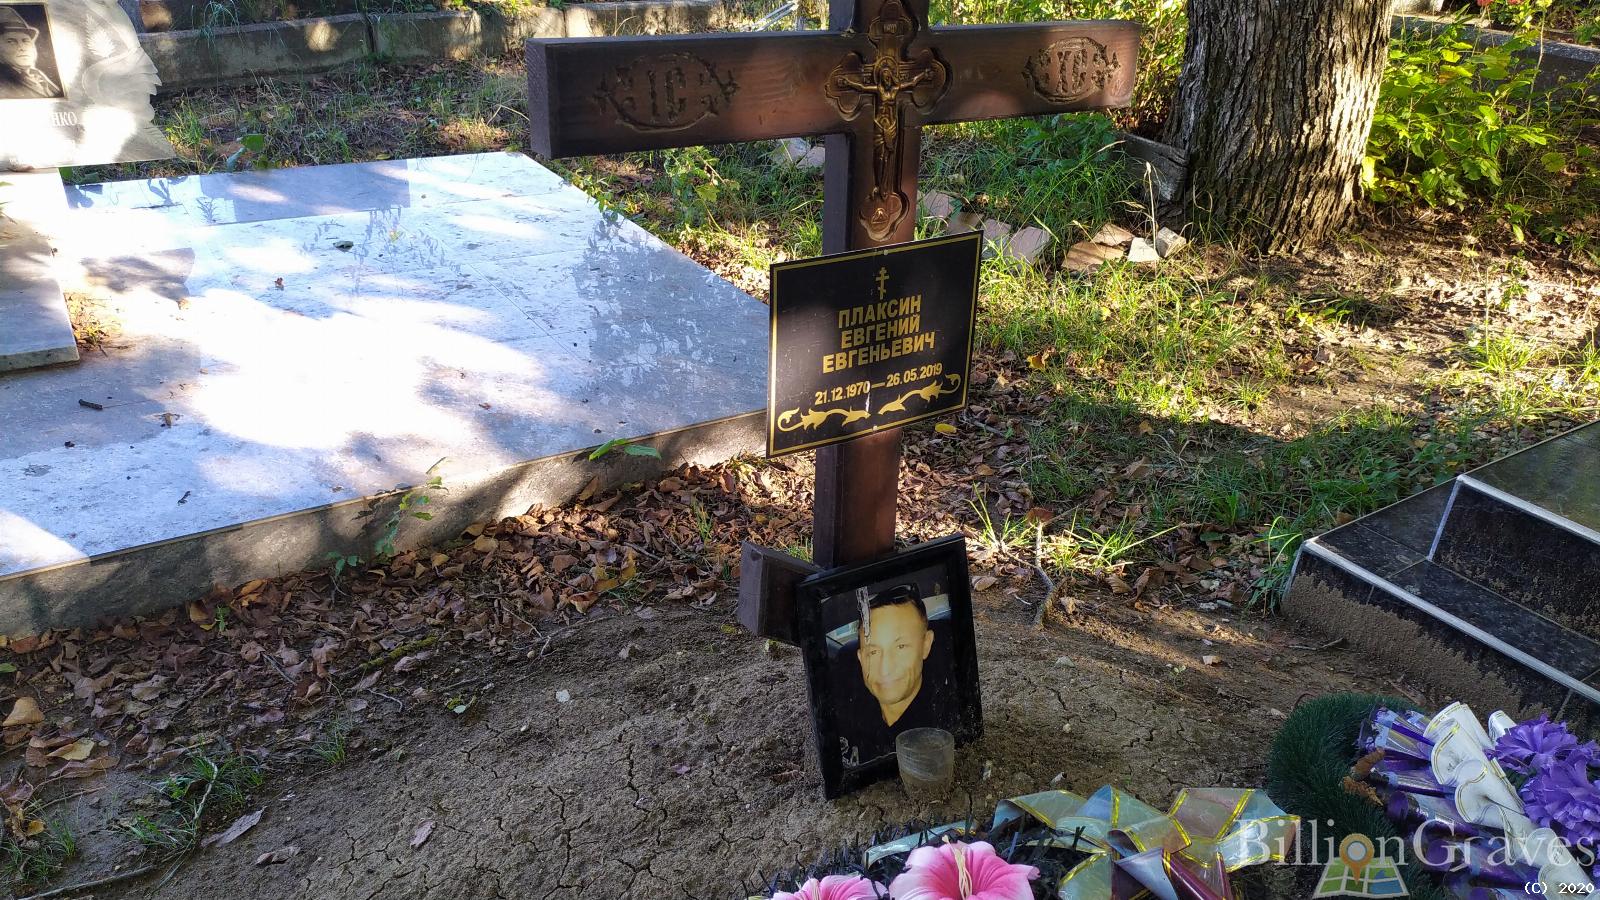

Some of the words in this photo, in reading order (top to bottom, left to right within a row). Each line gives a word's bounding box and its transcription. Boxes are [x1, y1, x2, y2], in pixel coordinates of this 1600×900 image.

[838, 294, 922, 329] ПЛАКСИН
[841, 314, 920, 349] ЕВГЕНИЙ
[822, 331, 936, 374] ЕВГЕНЬЕВИЧ
